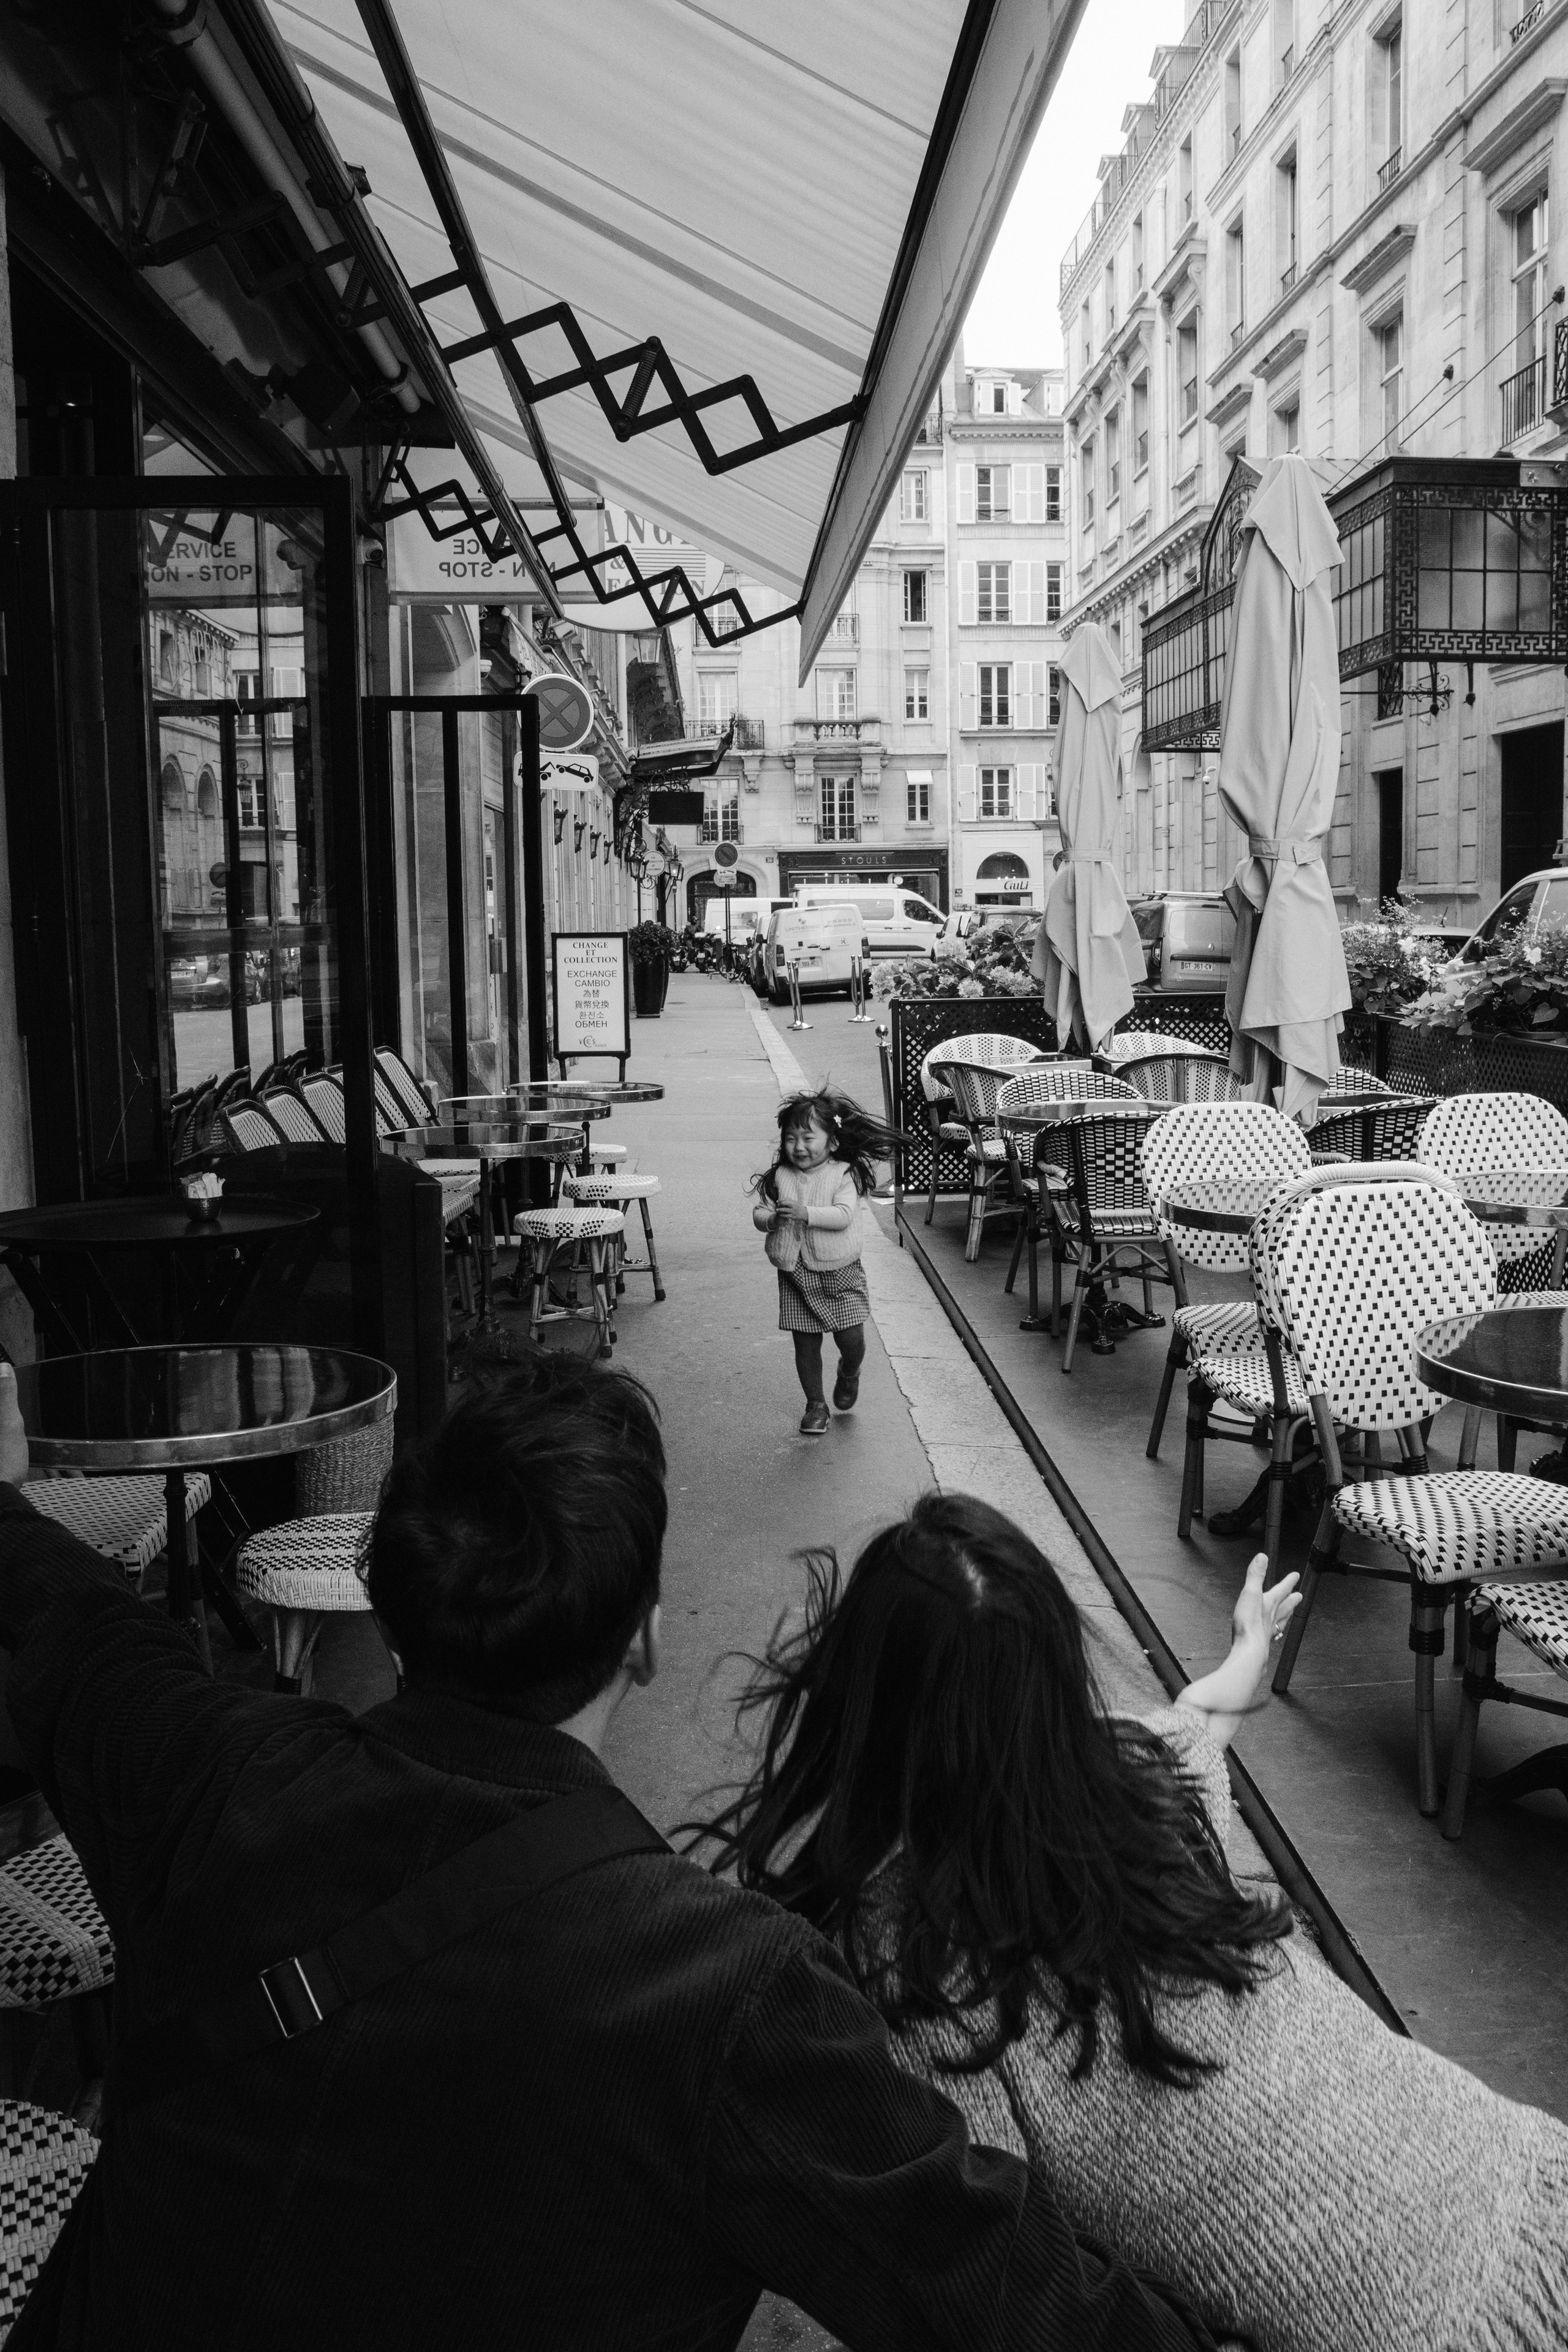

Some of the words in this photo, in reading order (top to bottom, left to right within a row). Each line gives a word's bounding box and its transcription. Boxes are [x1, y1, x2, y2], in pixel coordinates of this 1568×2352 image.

[199, 564, 252, 582] STOP
[841, 856, 887, 865] STOULS
[1004, 881, 1029, 890] GuLi
[785, 924, 821, 932] UNITHERMIC
[567, 970, 617, 978] EXCHANGE
[583, 989, 600, 998] 為替
[578, 1011, 605, 1020] 환전소
